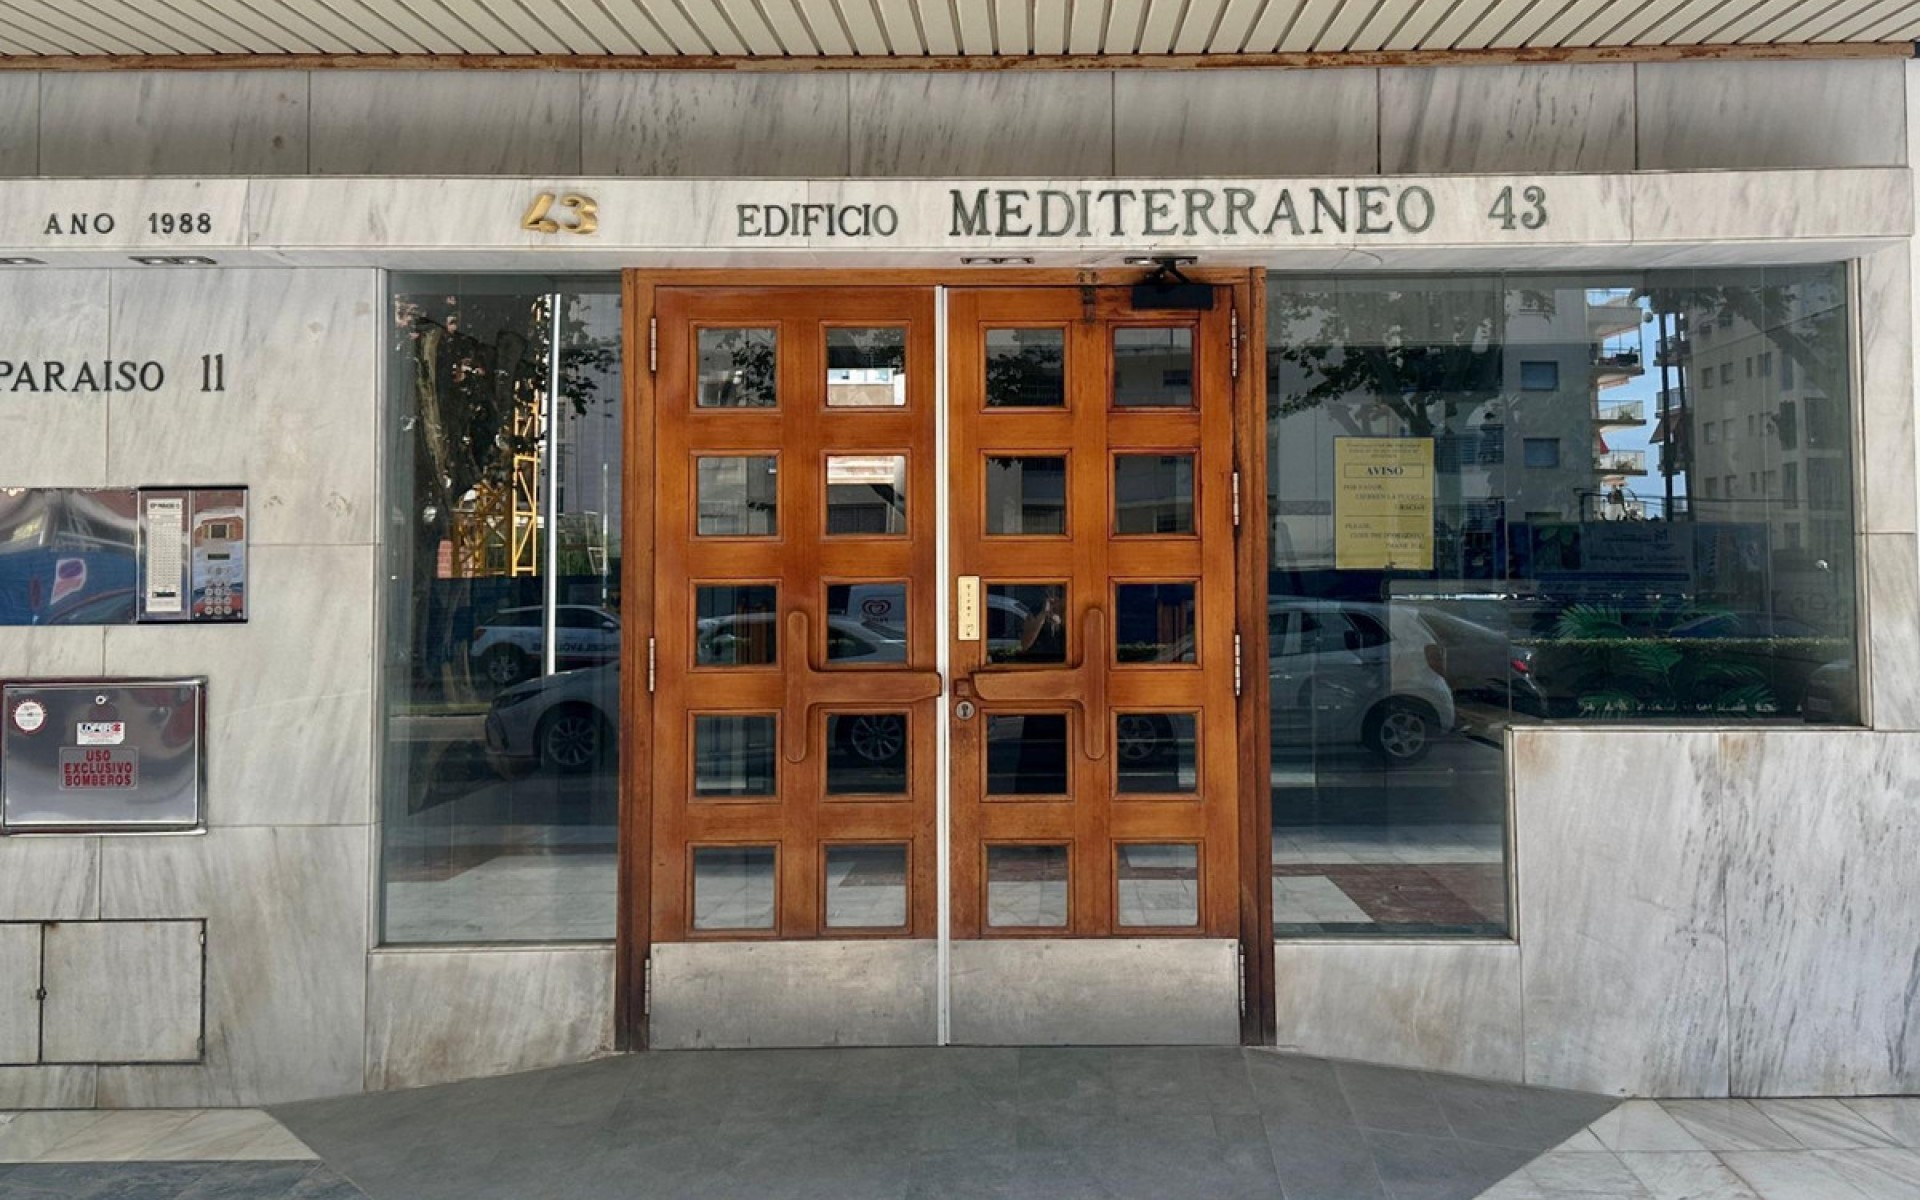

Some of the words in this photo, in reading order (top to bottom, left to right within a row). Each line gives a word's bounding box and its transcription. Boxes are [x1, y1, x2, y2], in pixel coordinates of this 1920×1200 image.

[521, 191, 598, 234] 43
[737, 204, 898, 237] EDIFICIO
[948, 185, 1435, 238] MEDITERRANEO
[1487, 184, 1548, 231] 43
[44, 212, 115, 235] ANO
[148, 212, 212, 235] 1988
[0, 360, 164, 393] PARAISO
[201, 353, 225, 392] 11
[1367, 466, 1404, 476] AVISO
[86, 750, 111, 762] USO
[64, 762, 132, 774] EXCLUSIVO
[65, 774, 132, 786] BOMBEROS
